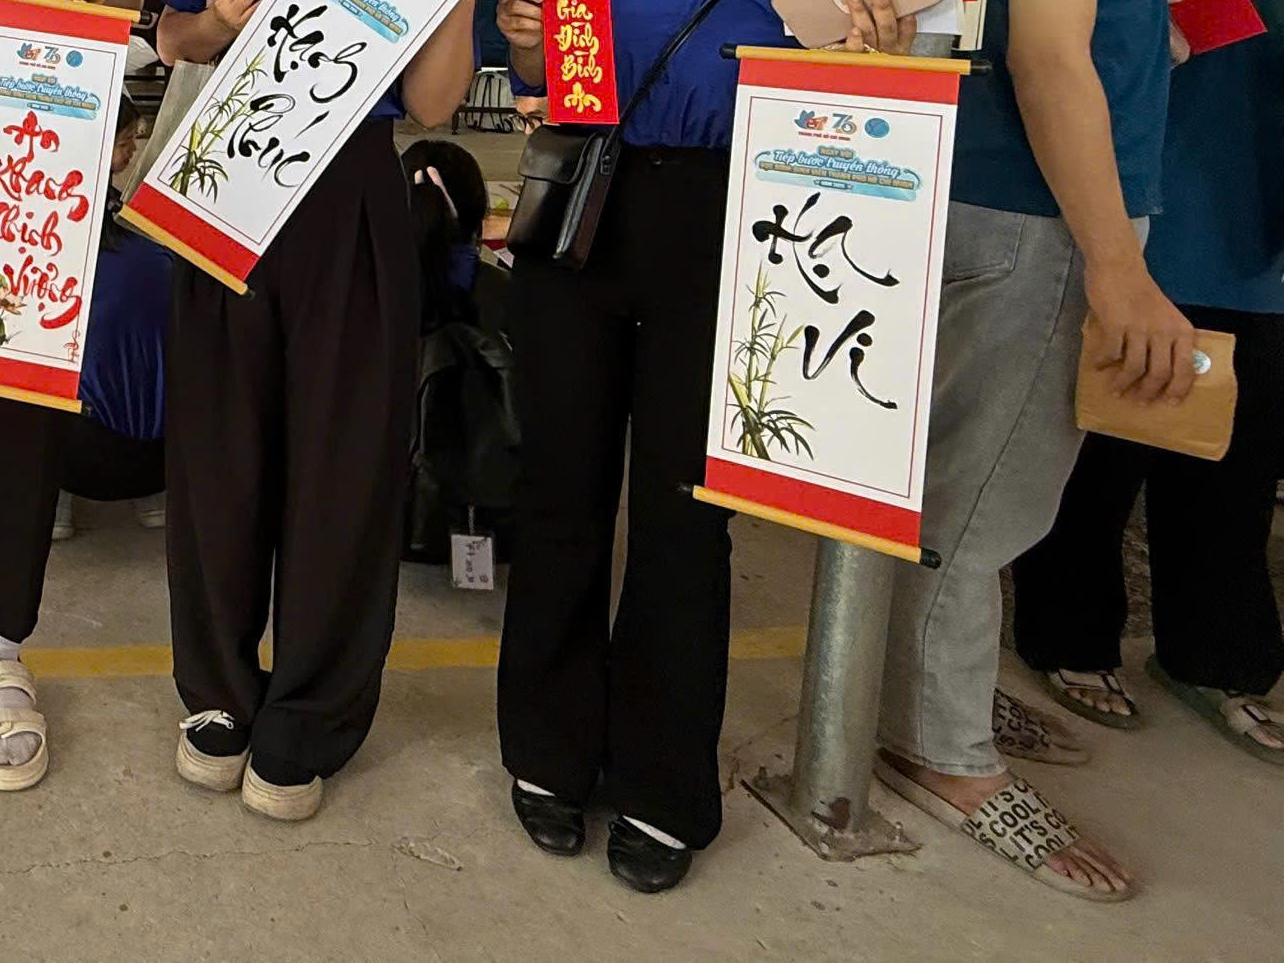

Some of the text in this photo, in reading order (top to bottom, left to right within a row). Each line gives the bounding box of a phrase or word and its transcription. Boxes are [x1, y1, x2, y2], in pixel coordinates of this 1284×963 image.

[267, 4, 367, 103] Hạnh
[553, 21, 600, 54] Đình
[561, 50, 603, 84] Bình
[563, 82, 602, 113] An
[227, 93, 329, 187] Phúc
[2, 252, 83, 330] Vượng
[803, 309, 898, 410] Vi
[989, 799, 1041, 838] COOL
[1010, 820, 1048, 853] IT'S
